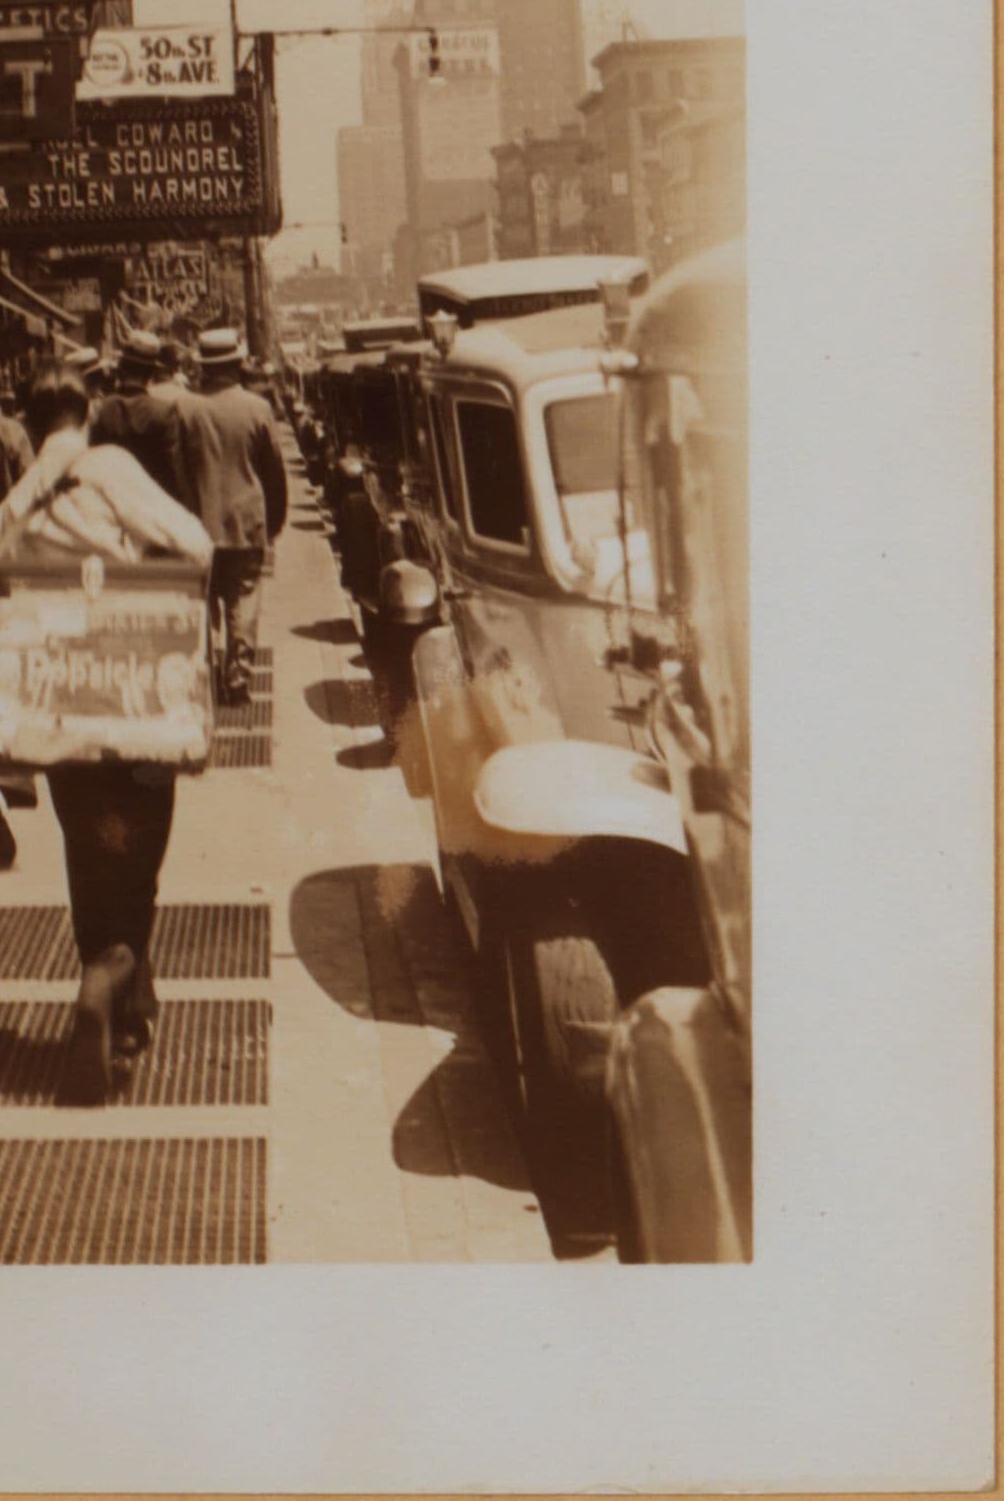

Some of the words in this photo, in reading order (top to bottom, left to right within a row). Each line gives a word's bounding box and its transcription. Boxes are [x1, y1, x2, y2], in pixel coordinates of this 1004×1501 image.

[188, 35, 215, 57] ST
[116, 120, 214, 147] COWARD
[49, 152, 91, 179] THE
[108, 146, 243, 177] SCOUNDREL
[28, 181, 115, 209] STOLEN
[132, 177, 244, 205] HARMONY
